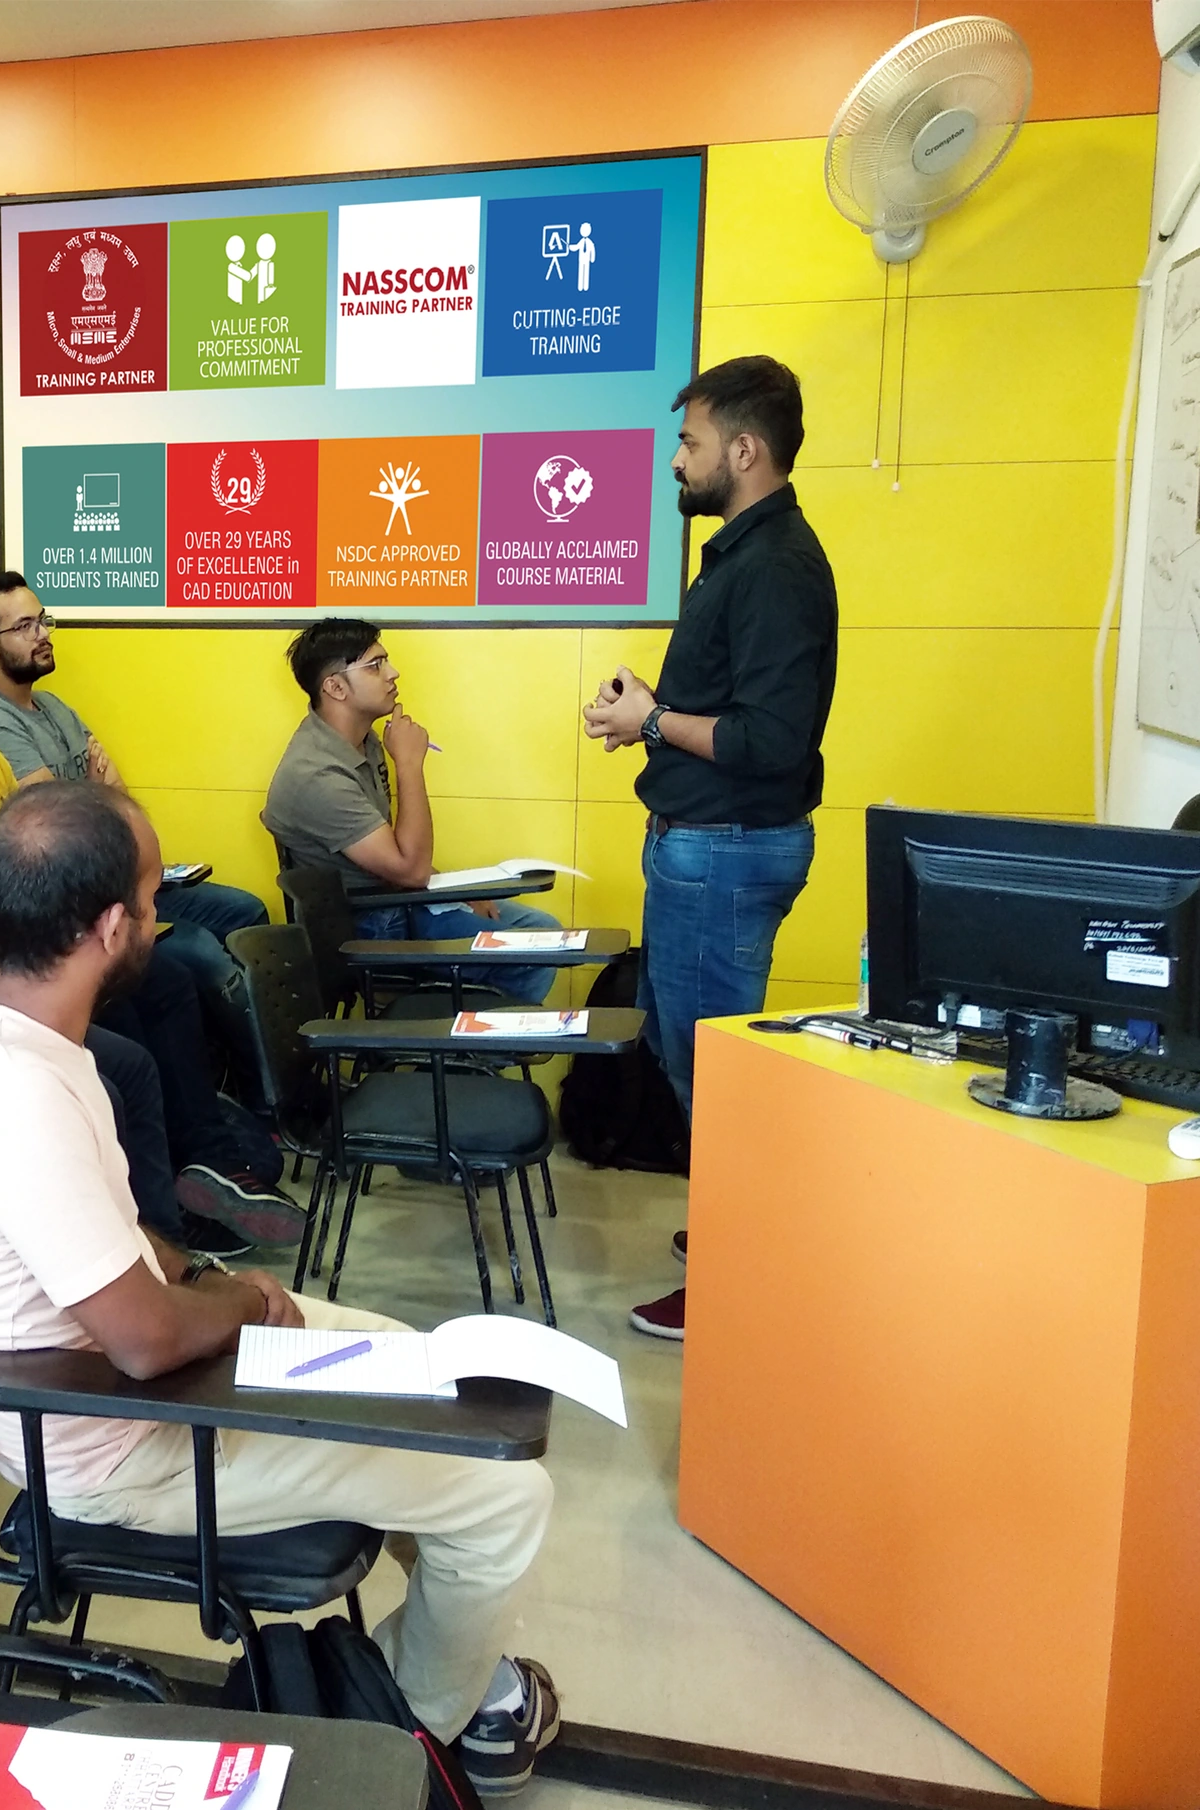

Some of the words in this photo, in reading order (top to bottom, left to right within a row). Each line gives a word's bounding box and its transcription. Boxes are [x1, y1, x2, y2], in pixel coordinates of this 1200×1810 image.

[924, 128, 965, 157] Crompton
[340, 299, 408, 317] TRAINING
[411, 296, 473, 314] PARTNER
[210, 317, 257, 337] VALUE
[260, 316, 290, 334] FOR
[512, 306, 622, 330] CUTTING-EDGE
[57, 338, 77, 360] Small
[84, 351, 115, 365] Medium
[113, 306, 142, 355] Enterprises
[529, 334, 602, 356] TRAINING
[197, 336, 303, 358] PROFESSIONAL
[199, 357, 301, 379] COMMITMENT
[35, 372, 97, 389] TRAINING
[99, 370, 156, 386] PARTNER
[227, 476, 251, 504] 29
[184, 531, 222, 550] OVER
[225, 531, 243, 549] 29
[245, 530, 292, 549] YEARS
[485, 540, 553, 560] GLOBALLY
[556, 539, 639, 559] ACCLAIMED
[42, 547, 75, 566] OVER
[79, 547, 97, 565] 1.4
[100, 546, 153, 565] MILLION
[336, 545, 377, 562] NSDC
[380, 544, 461, 562] APPROVED
[176, 557, 195, 576] OF
[198, 556, 284, 575] EXCELLENCE
[288, 556, 300, 575] in
[496, 567, 551, 586] COURSE
[554, 566, 625, 586] MATERIAL
[36, 571, 101, 589] STUDENTS
[104, 571, 160, 588] TRAINED
[327, 569, 397, 587] TRAINING
[400, 569, 469, 587] PARTNER
[183, 582, 211, 600] CAD
[214, 581, 293, 600] EDUCATION
